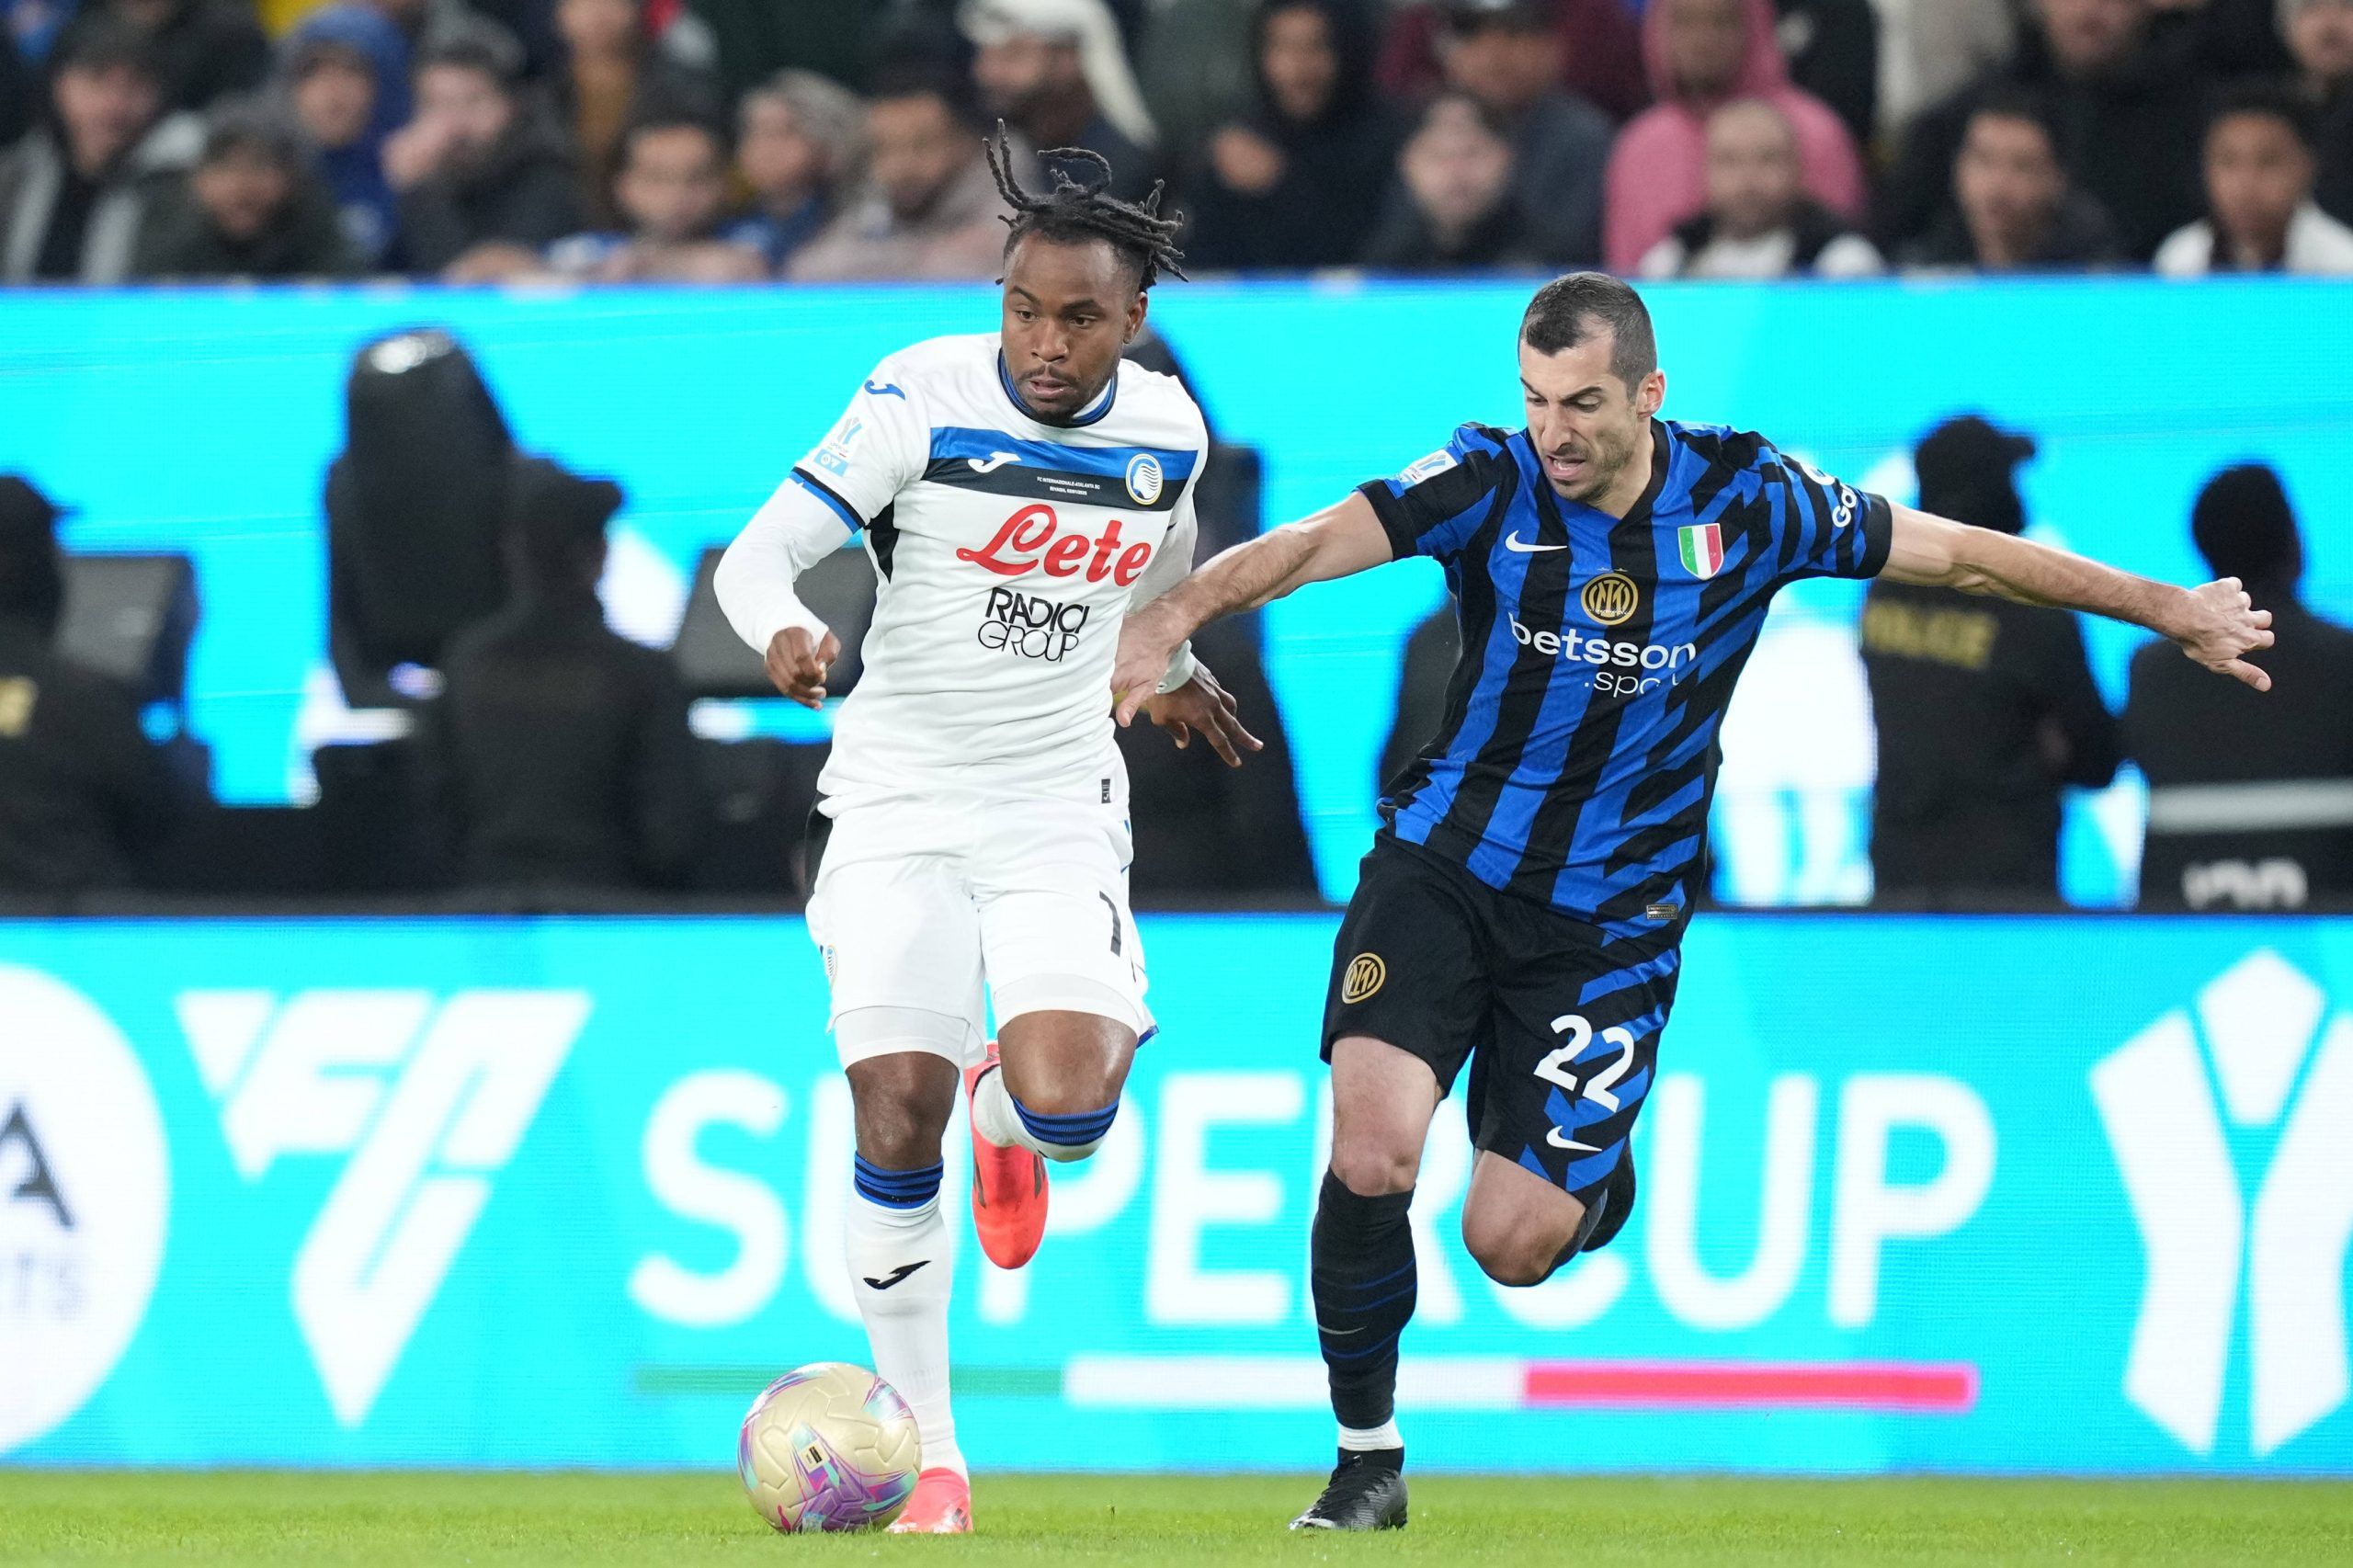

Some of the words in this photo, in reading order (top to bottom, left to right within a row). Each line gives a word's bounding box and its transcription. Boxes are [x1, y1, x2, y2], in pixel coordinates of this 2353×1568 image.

[956, 504, 1152, 586] Lete
[985, 587, 1090, 634] RADICI
[978, 620, 1079, 663] GROUP
[1508, 612, 1696, 669] betsson
[1533, 1015, 1634, 1113] 22
